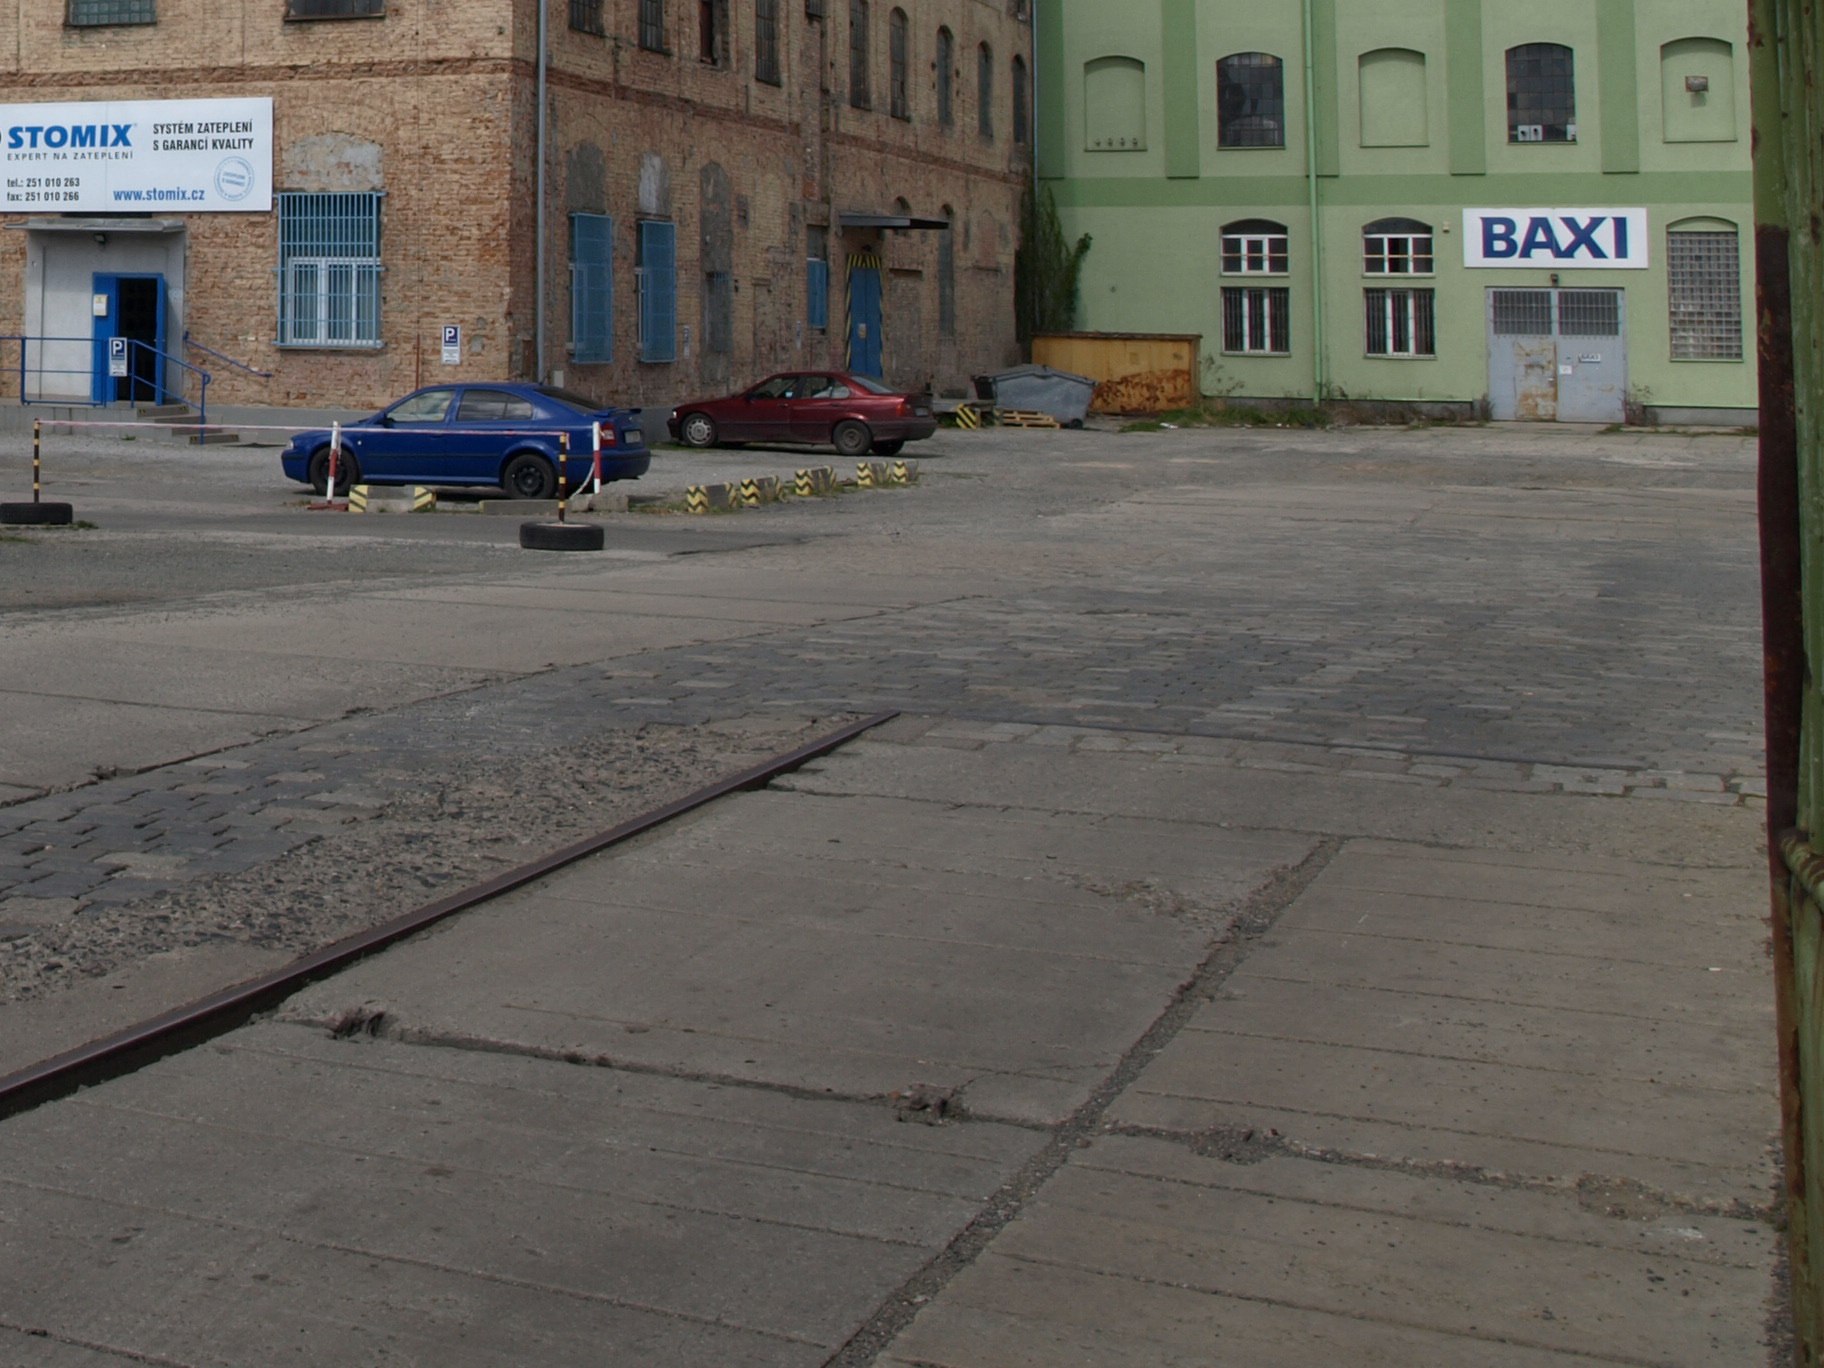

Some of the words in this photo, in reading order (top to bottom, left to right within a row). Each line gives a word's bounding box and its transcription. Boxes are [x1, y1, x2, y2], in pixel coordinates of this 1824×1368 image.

[153, 120, 194, 135] SYSTÉM
[197, 119, 254, 134] ZATEPLENÍ
[7, 123, 133, 149] STOMIX
[153, 139, 159, 151] S
[162, 136, 209, 151] GARANCÍ
[212, 137, 254, 150] KVALITY
[7, 152, 48, 161] EXPERT
[53, 151, 68, 160] NA
[73, 150, 134, 160] ZATEPLENÍ
[26, 177, 41, 187] 251
[44, 177, 60, 187] 010
[25, 191, 41, 201] 251
[44, 191, 60, 201] 010
[113, 186, 205, 201] www.stomix.cz
[1479, 216, 1628, 259] BAXI
[445, 328, 455, 342] P
[113, 340, 123, 356] P
